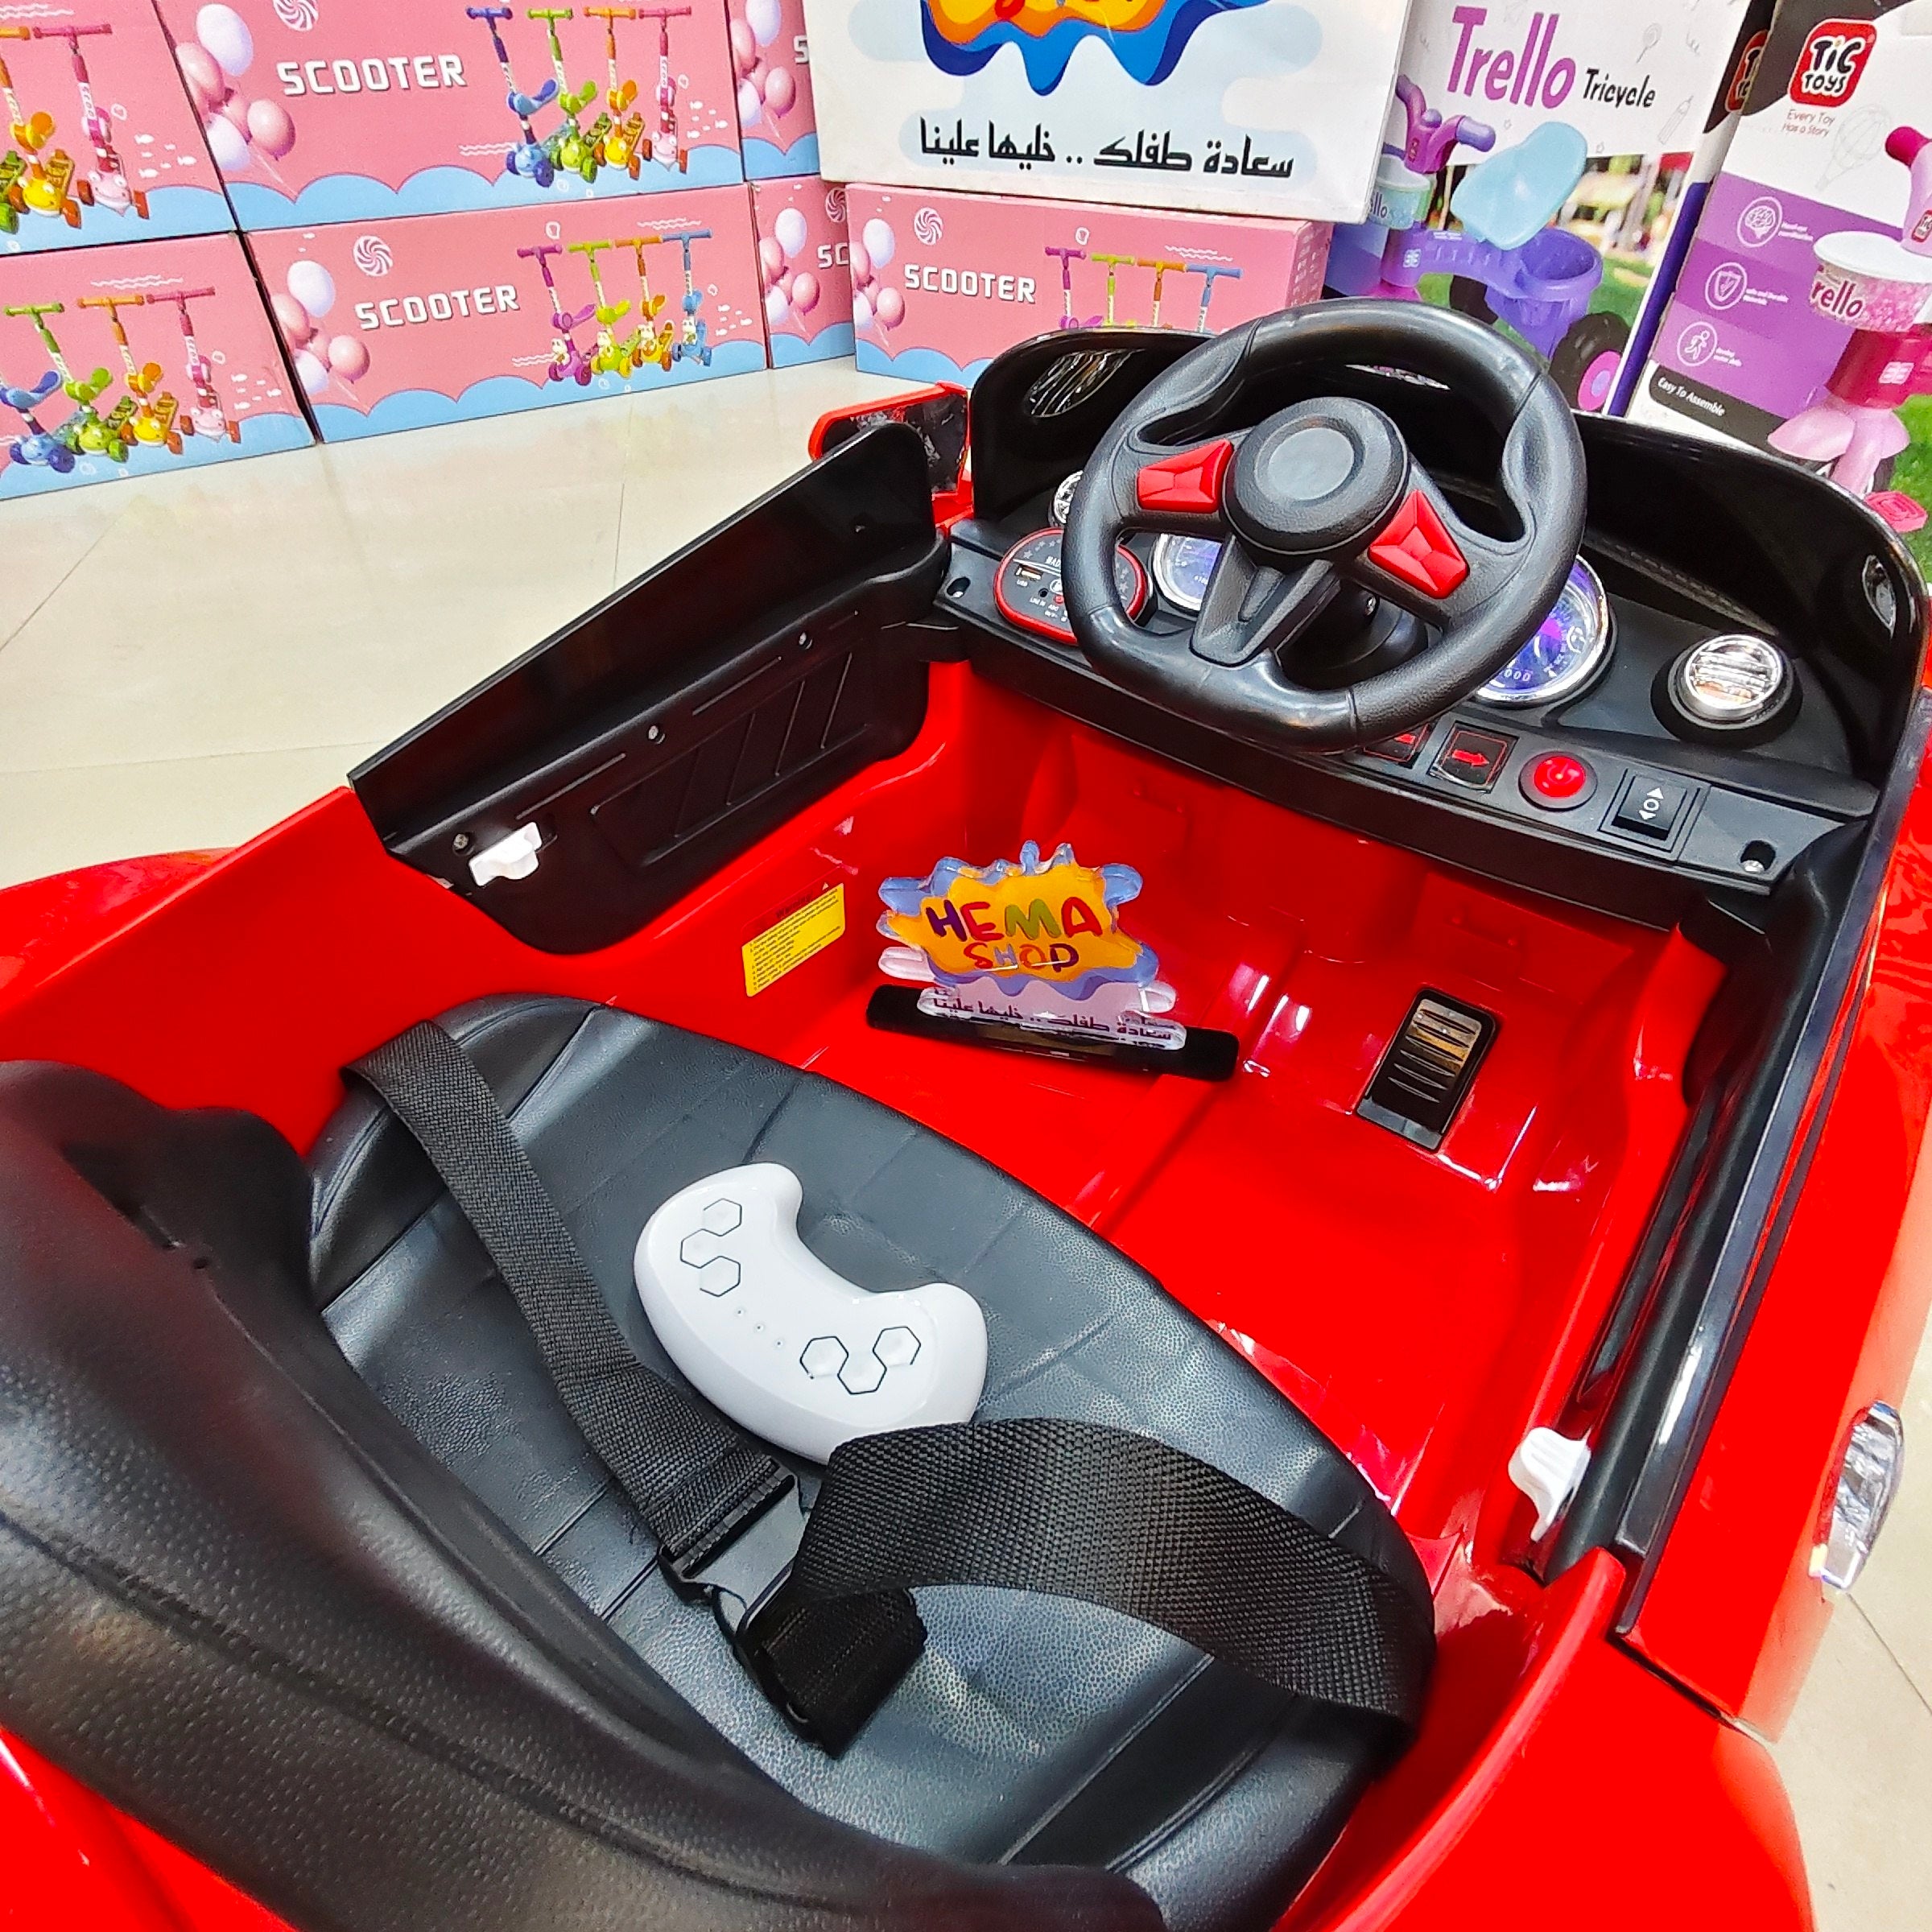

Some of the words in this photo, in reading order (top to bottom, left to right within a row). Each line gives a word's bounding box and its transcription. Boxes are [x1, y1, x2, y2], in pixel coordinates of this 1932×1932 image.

[276, 53, 468, 96] SCOOTER
[1447, 6, 1576, 109] Trello
[1583, 67, 1656, 109] Tricycle
[1804, 73, 1847, 93] TOYS
[1786, 109, 1816, 123] Every
[1818, 112, 1835, 127] Toy
[920, 116, 980, 165] علينا
[989, 119, 1055, 170] خليها
[1093, 129, 1193, 171] طفلك
[1203, 134, 1294, 179] سعادة
[904, 263, 1036, 303] SCOOTER
[354, 284, 520, 330] SCOOTER
[1657, 377, 1677, 394] Easy
[1677, 385, 1687, 398] To
[1686, 391, 1726, 417] Assemble
[925, 896, 1104, 942] HEMA
[963, 942, 1080, 973] SHOP
[1117, 1021, 1172, 1041] سعادة
